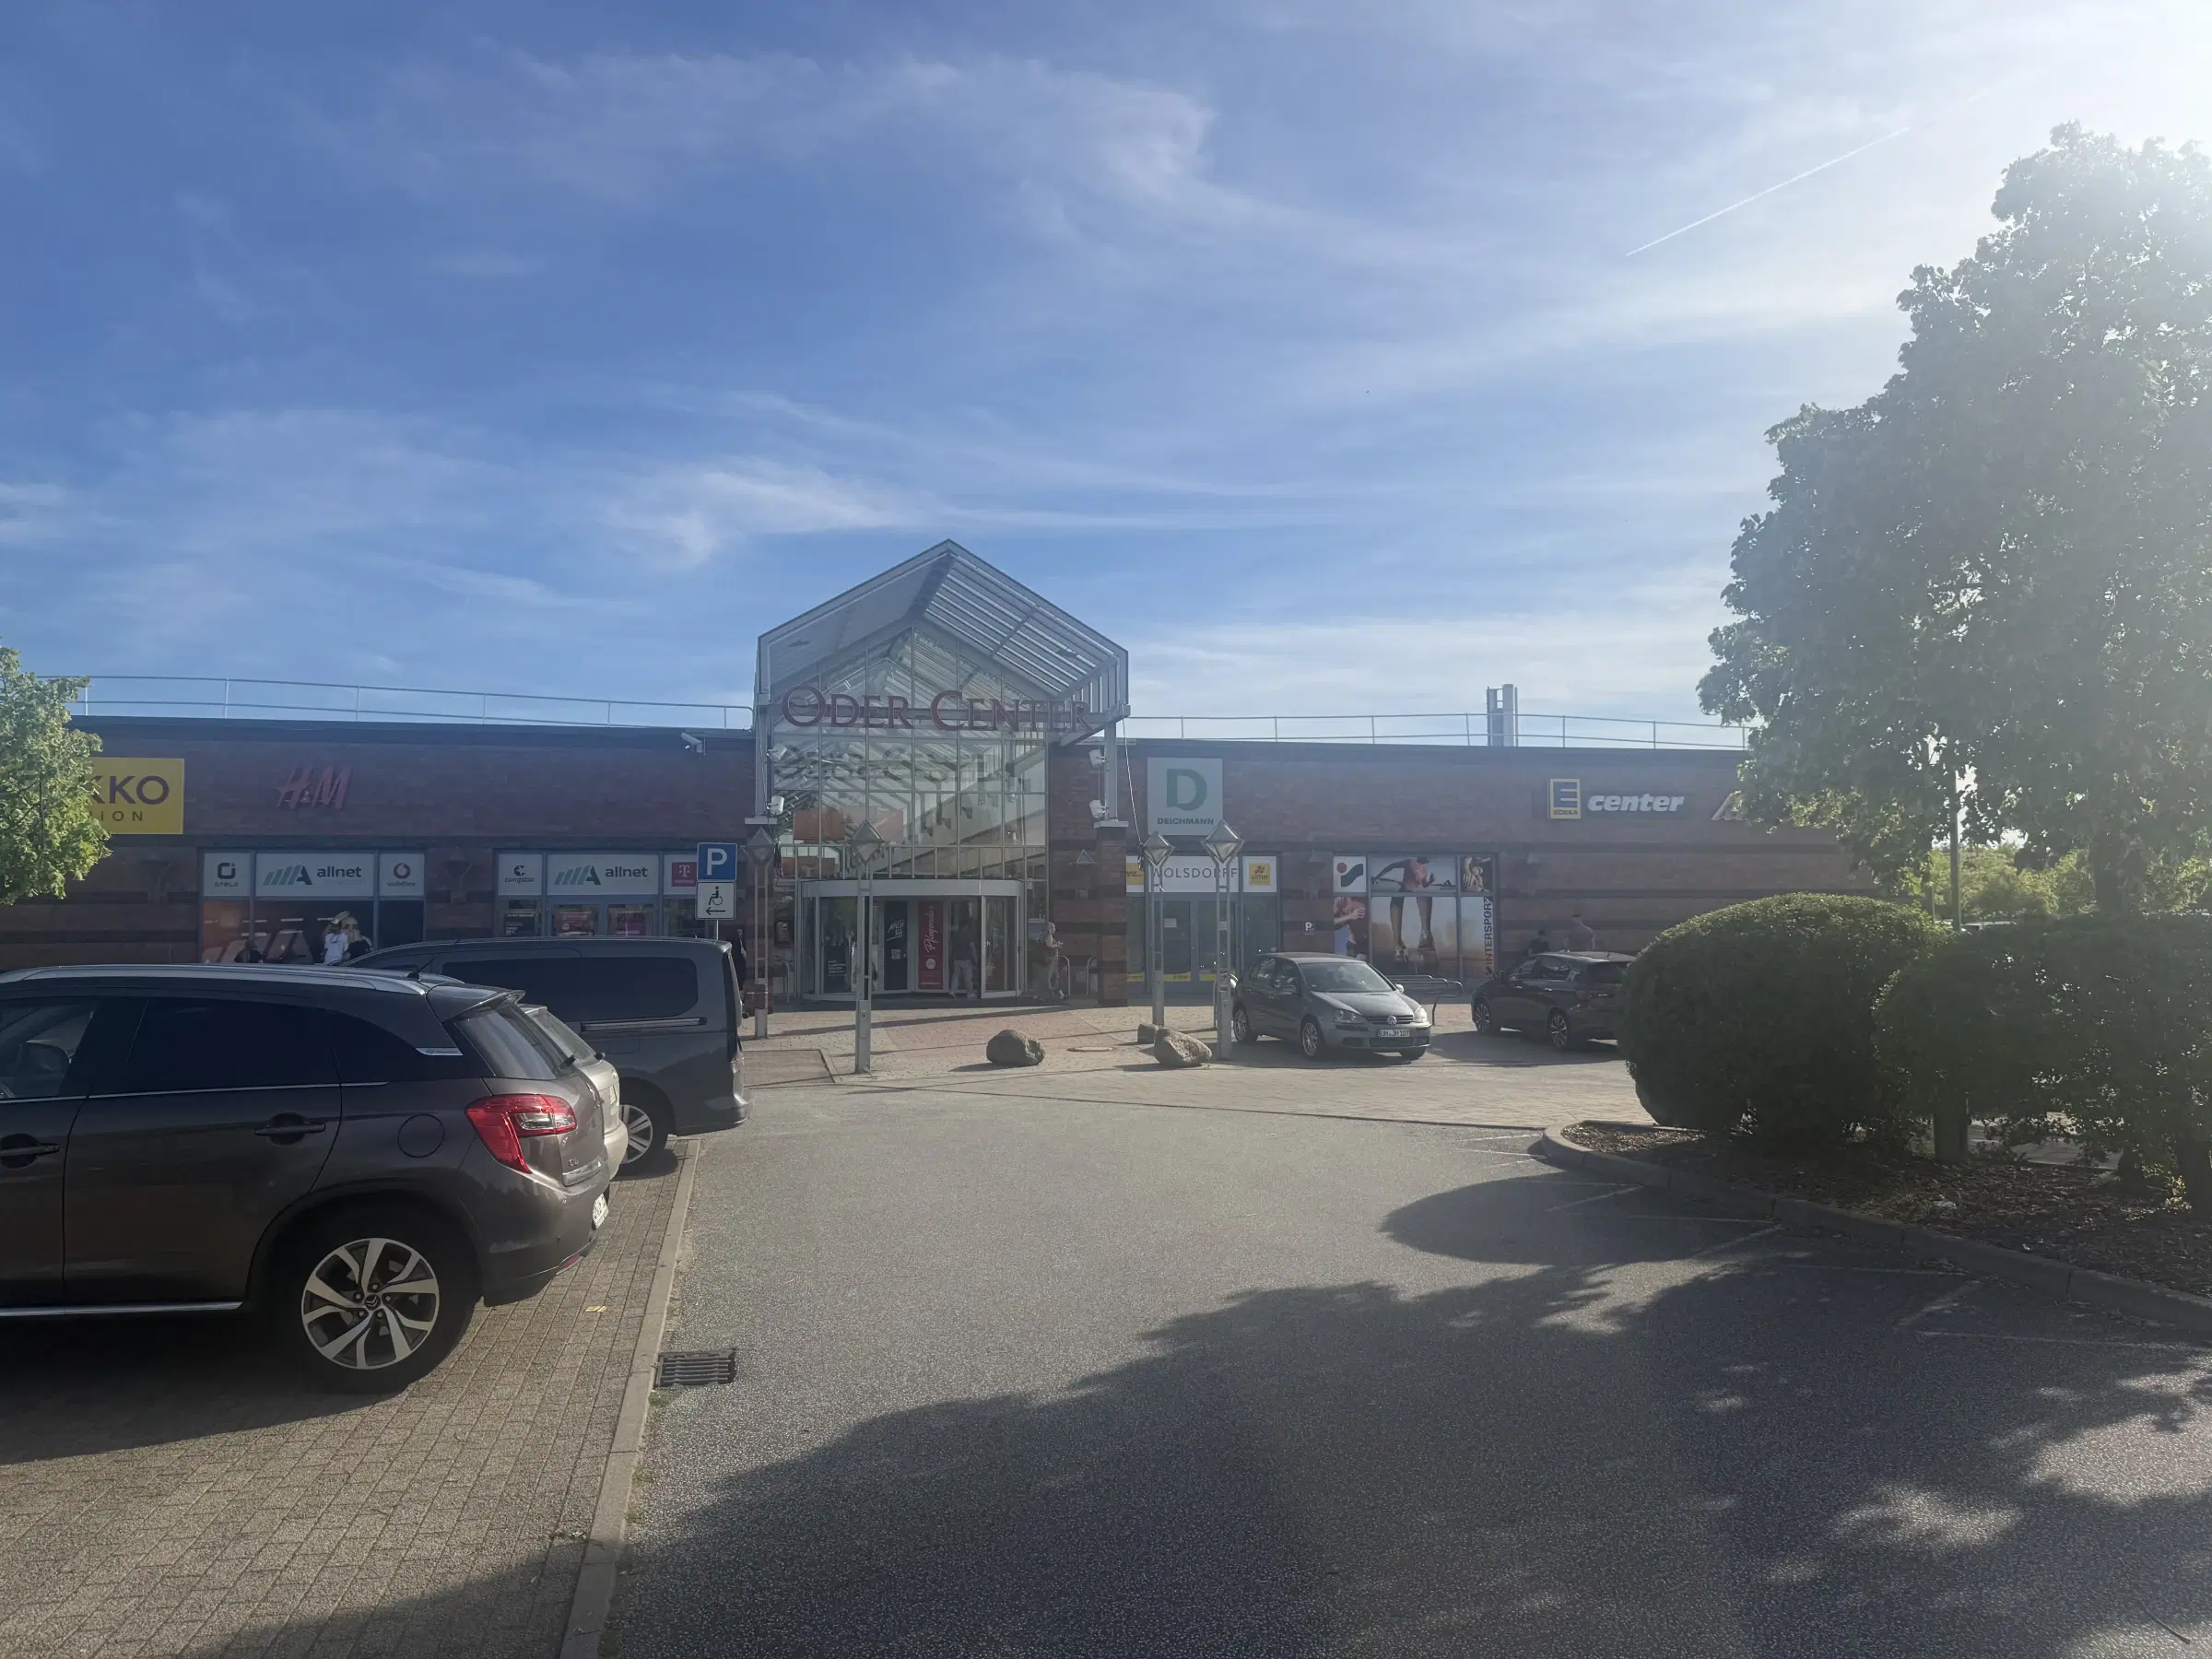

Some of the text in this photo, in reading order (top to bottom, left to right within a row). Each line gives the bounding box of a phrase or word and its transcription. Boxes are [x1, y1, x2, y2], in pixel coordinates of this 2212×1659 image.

[1588, 794, 1685, 812] center
[707, 848, 728, 876] P
[317, 865, 362, 878] allnet
[605, 865, 649, 878] allnet
[1483, 897, 1493, 965] INTERSPORT
